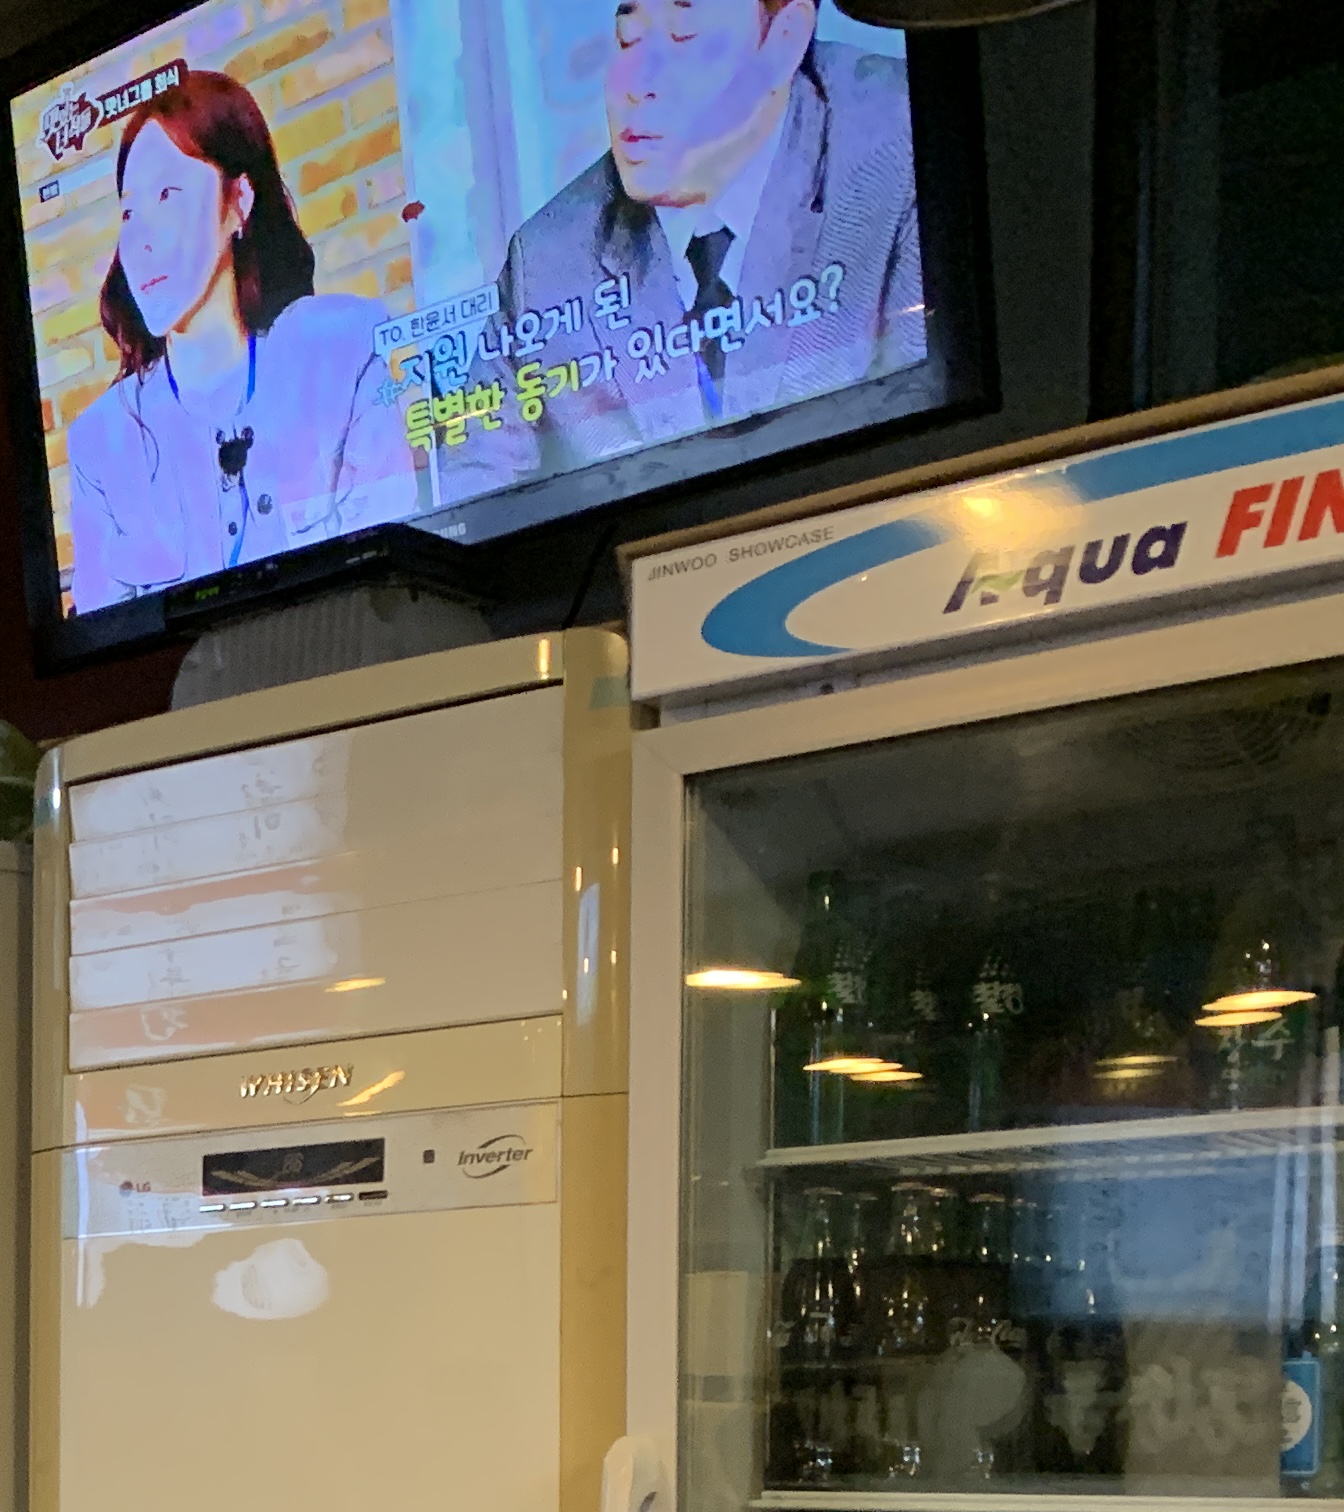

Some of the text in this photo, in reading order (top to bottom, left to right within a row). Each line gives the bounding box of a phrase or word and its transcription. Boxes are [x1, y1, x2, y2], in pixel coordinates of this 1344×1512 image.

[460, 291, 494, 320] 대리
[478, 296, 584, 364] 나오게
[594, 274, 633, 331] 된
[405, 264, 848, 453] 특별한 동기가 있다면서요?
[647, 526, 835, 582] JINWOO SHOWCASE
[942, 520, 1189, 616] Aqua
[457, 1146, 535, 1168] Inverter
[136, 1182, 153, 1195] LG
